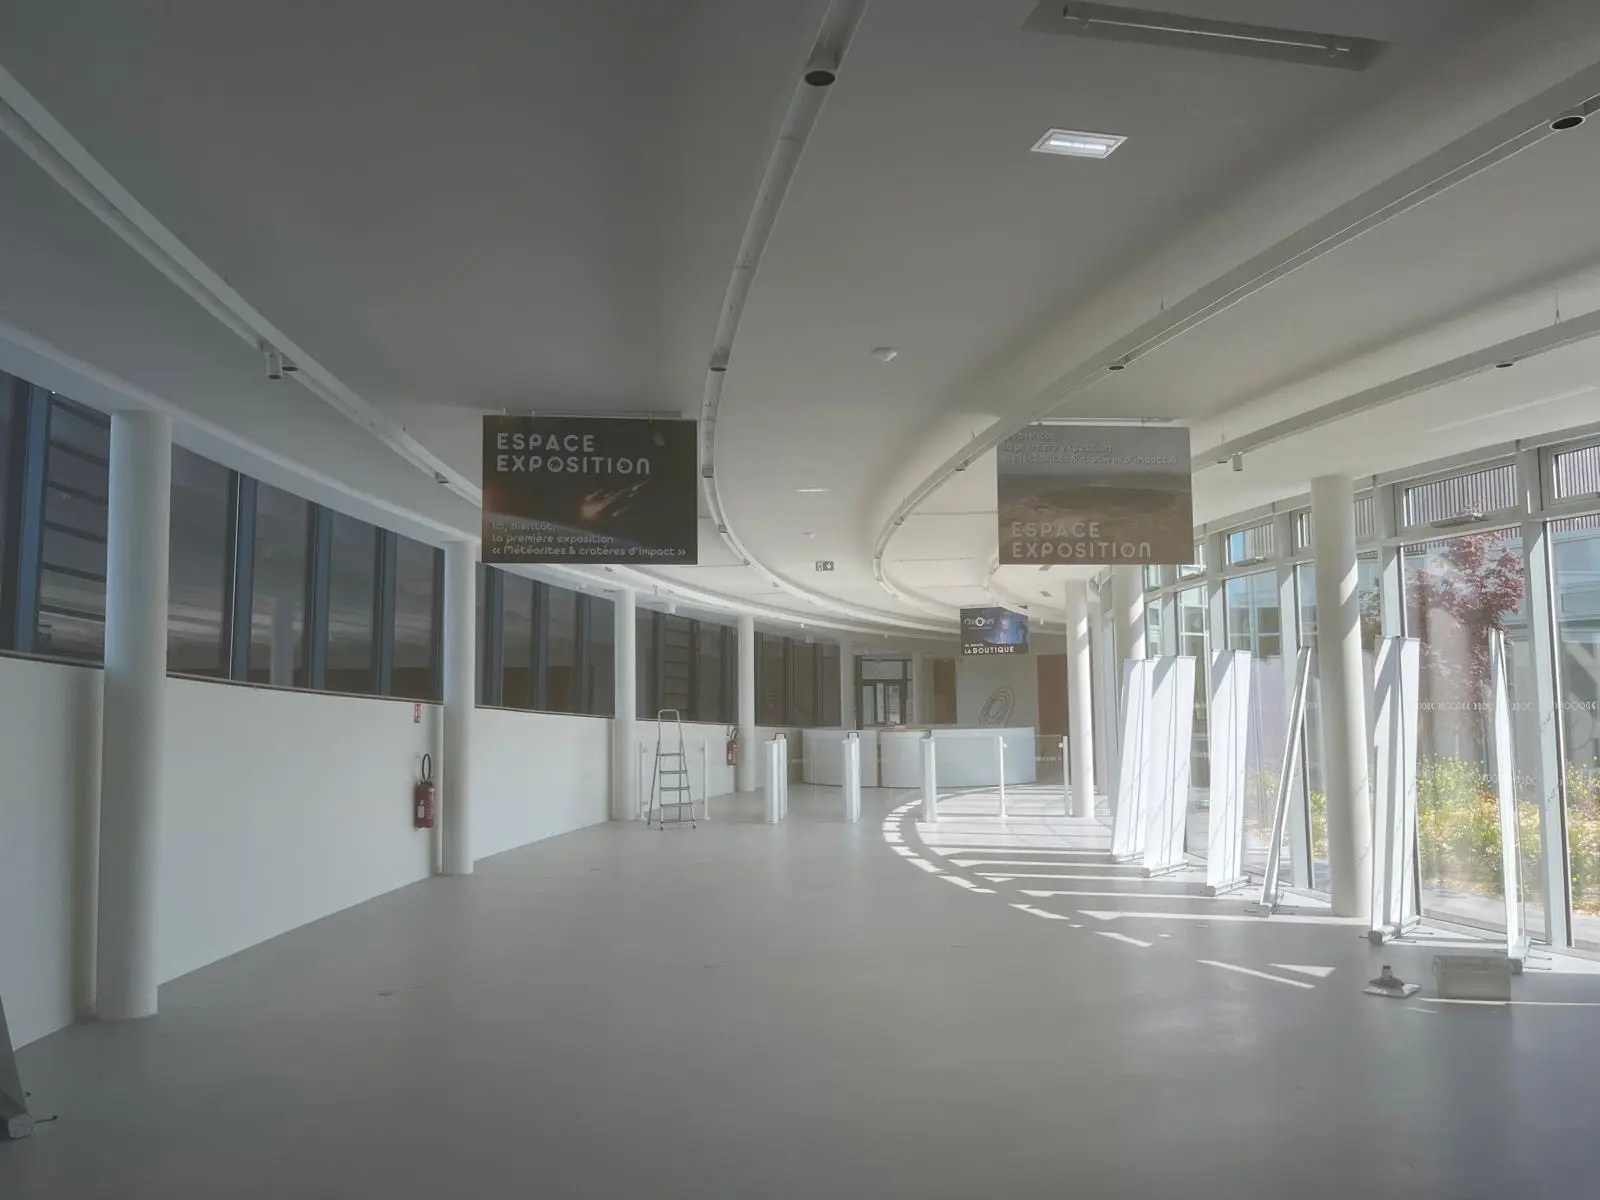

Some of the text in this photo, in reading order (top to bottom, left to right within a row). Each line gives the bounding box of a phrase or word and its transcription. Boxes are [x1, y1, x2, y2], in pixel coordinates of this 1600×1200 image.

[497, 432, 595, 452] ESPACE
[1012, 522, 1100, 538] ESPACE
[506, 533, 553, 545] première
[557, 534, 614, 545] exposition
[568, 546, 576, 555] &
[579, 544, 626, 556] cratères
[972, 646, 1015, 654] BOUTIQUE
